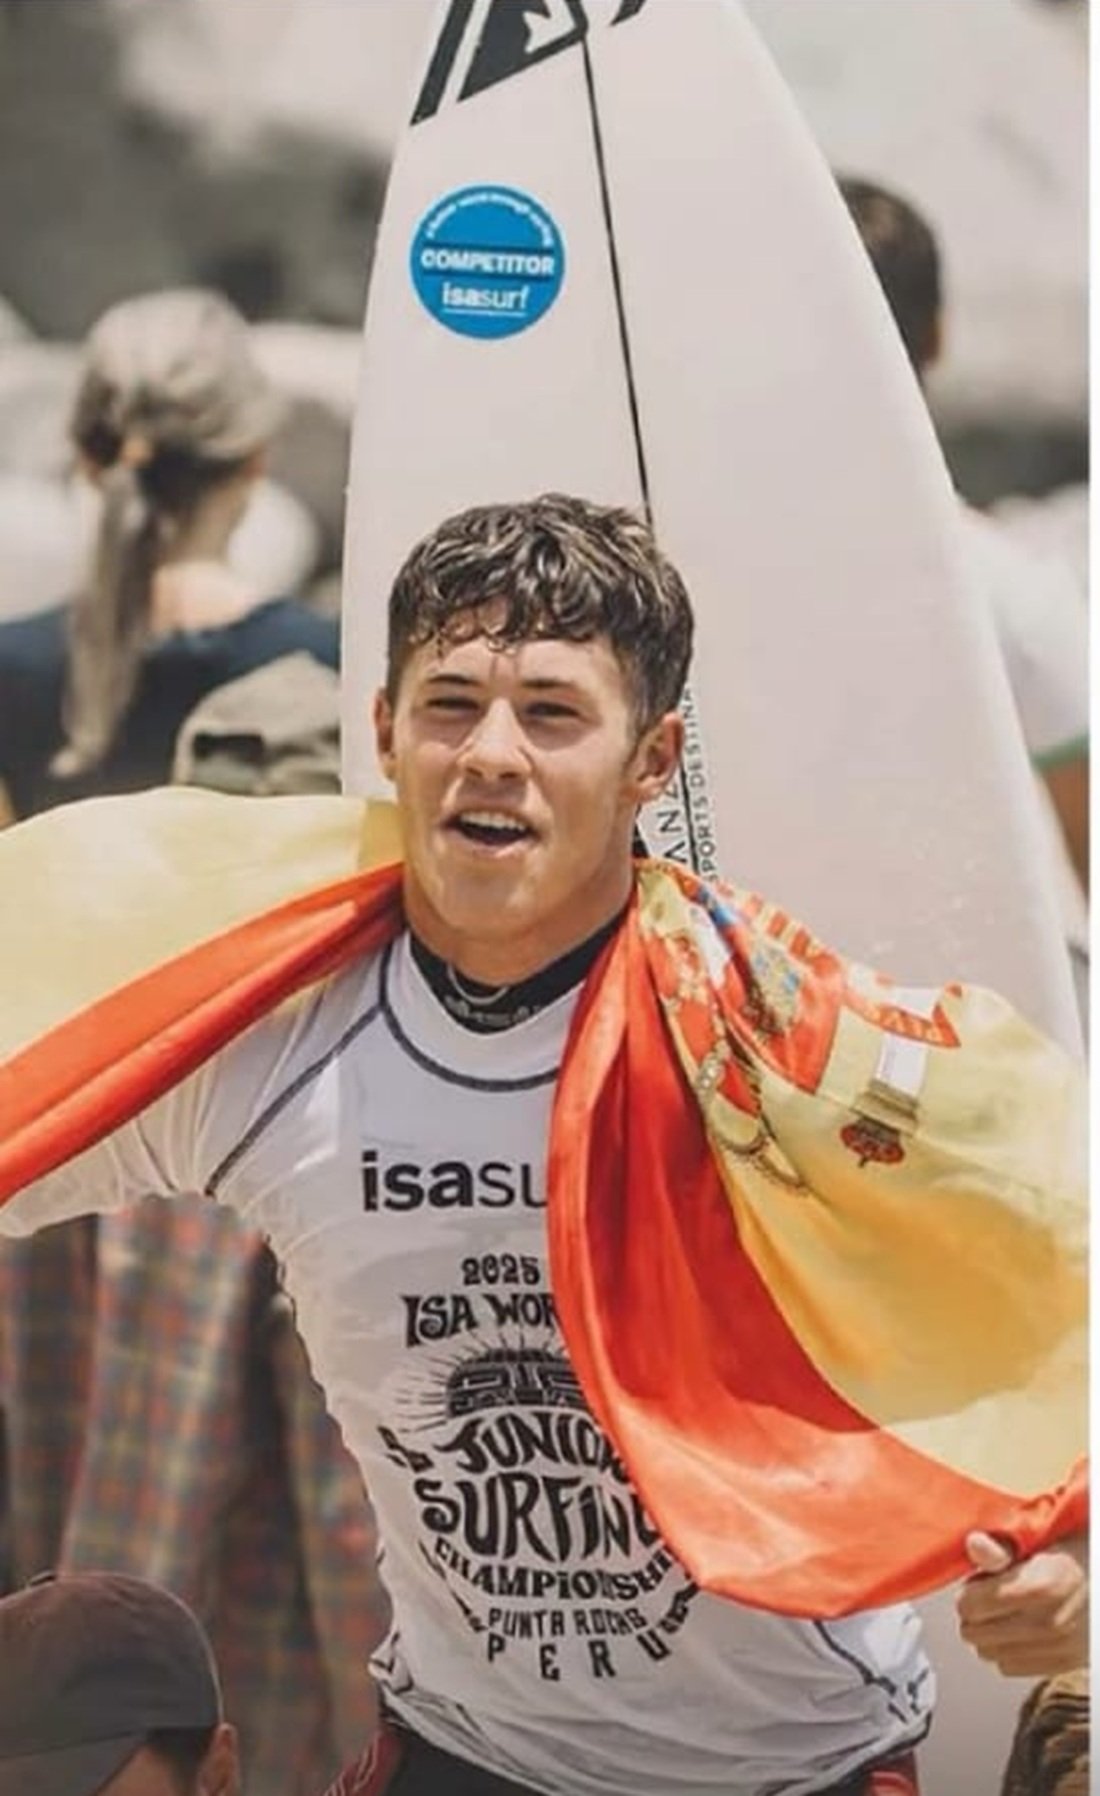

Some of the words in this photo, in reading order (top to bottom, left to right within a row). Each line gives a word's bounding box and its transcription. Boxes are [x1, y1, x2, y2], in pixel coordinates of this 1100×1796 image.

[420, 248, 556, 276] COMPETITOR
[442, 280, 530, 310] isasurf
[461, 1253, 541, 1286] 2025
[401, 1295, 479, 1349] ISA
[488, 1607, 566, 1639] PUNTA
[486, 1630, 672, 1682] PERU
